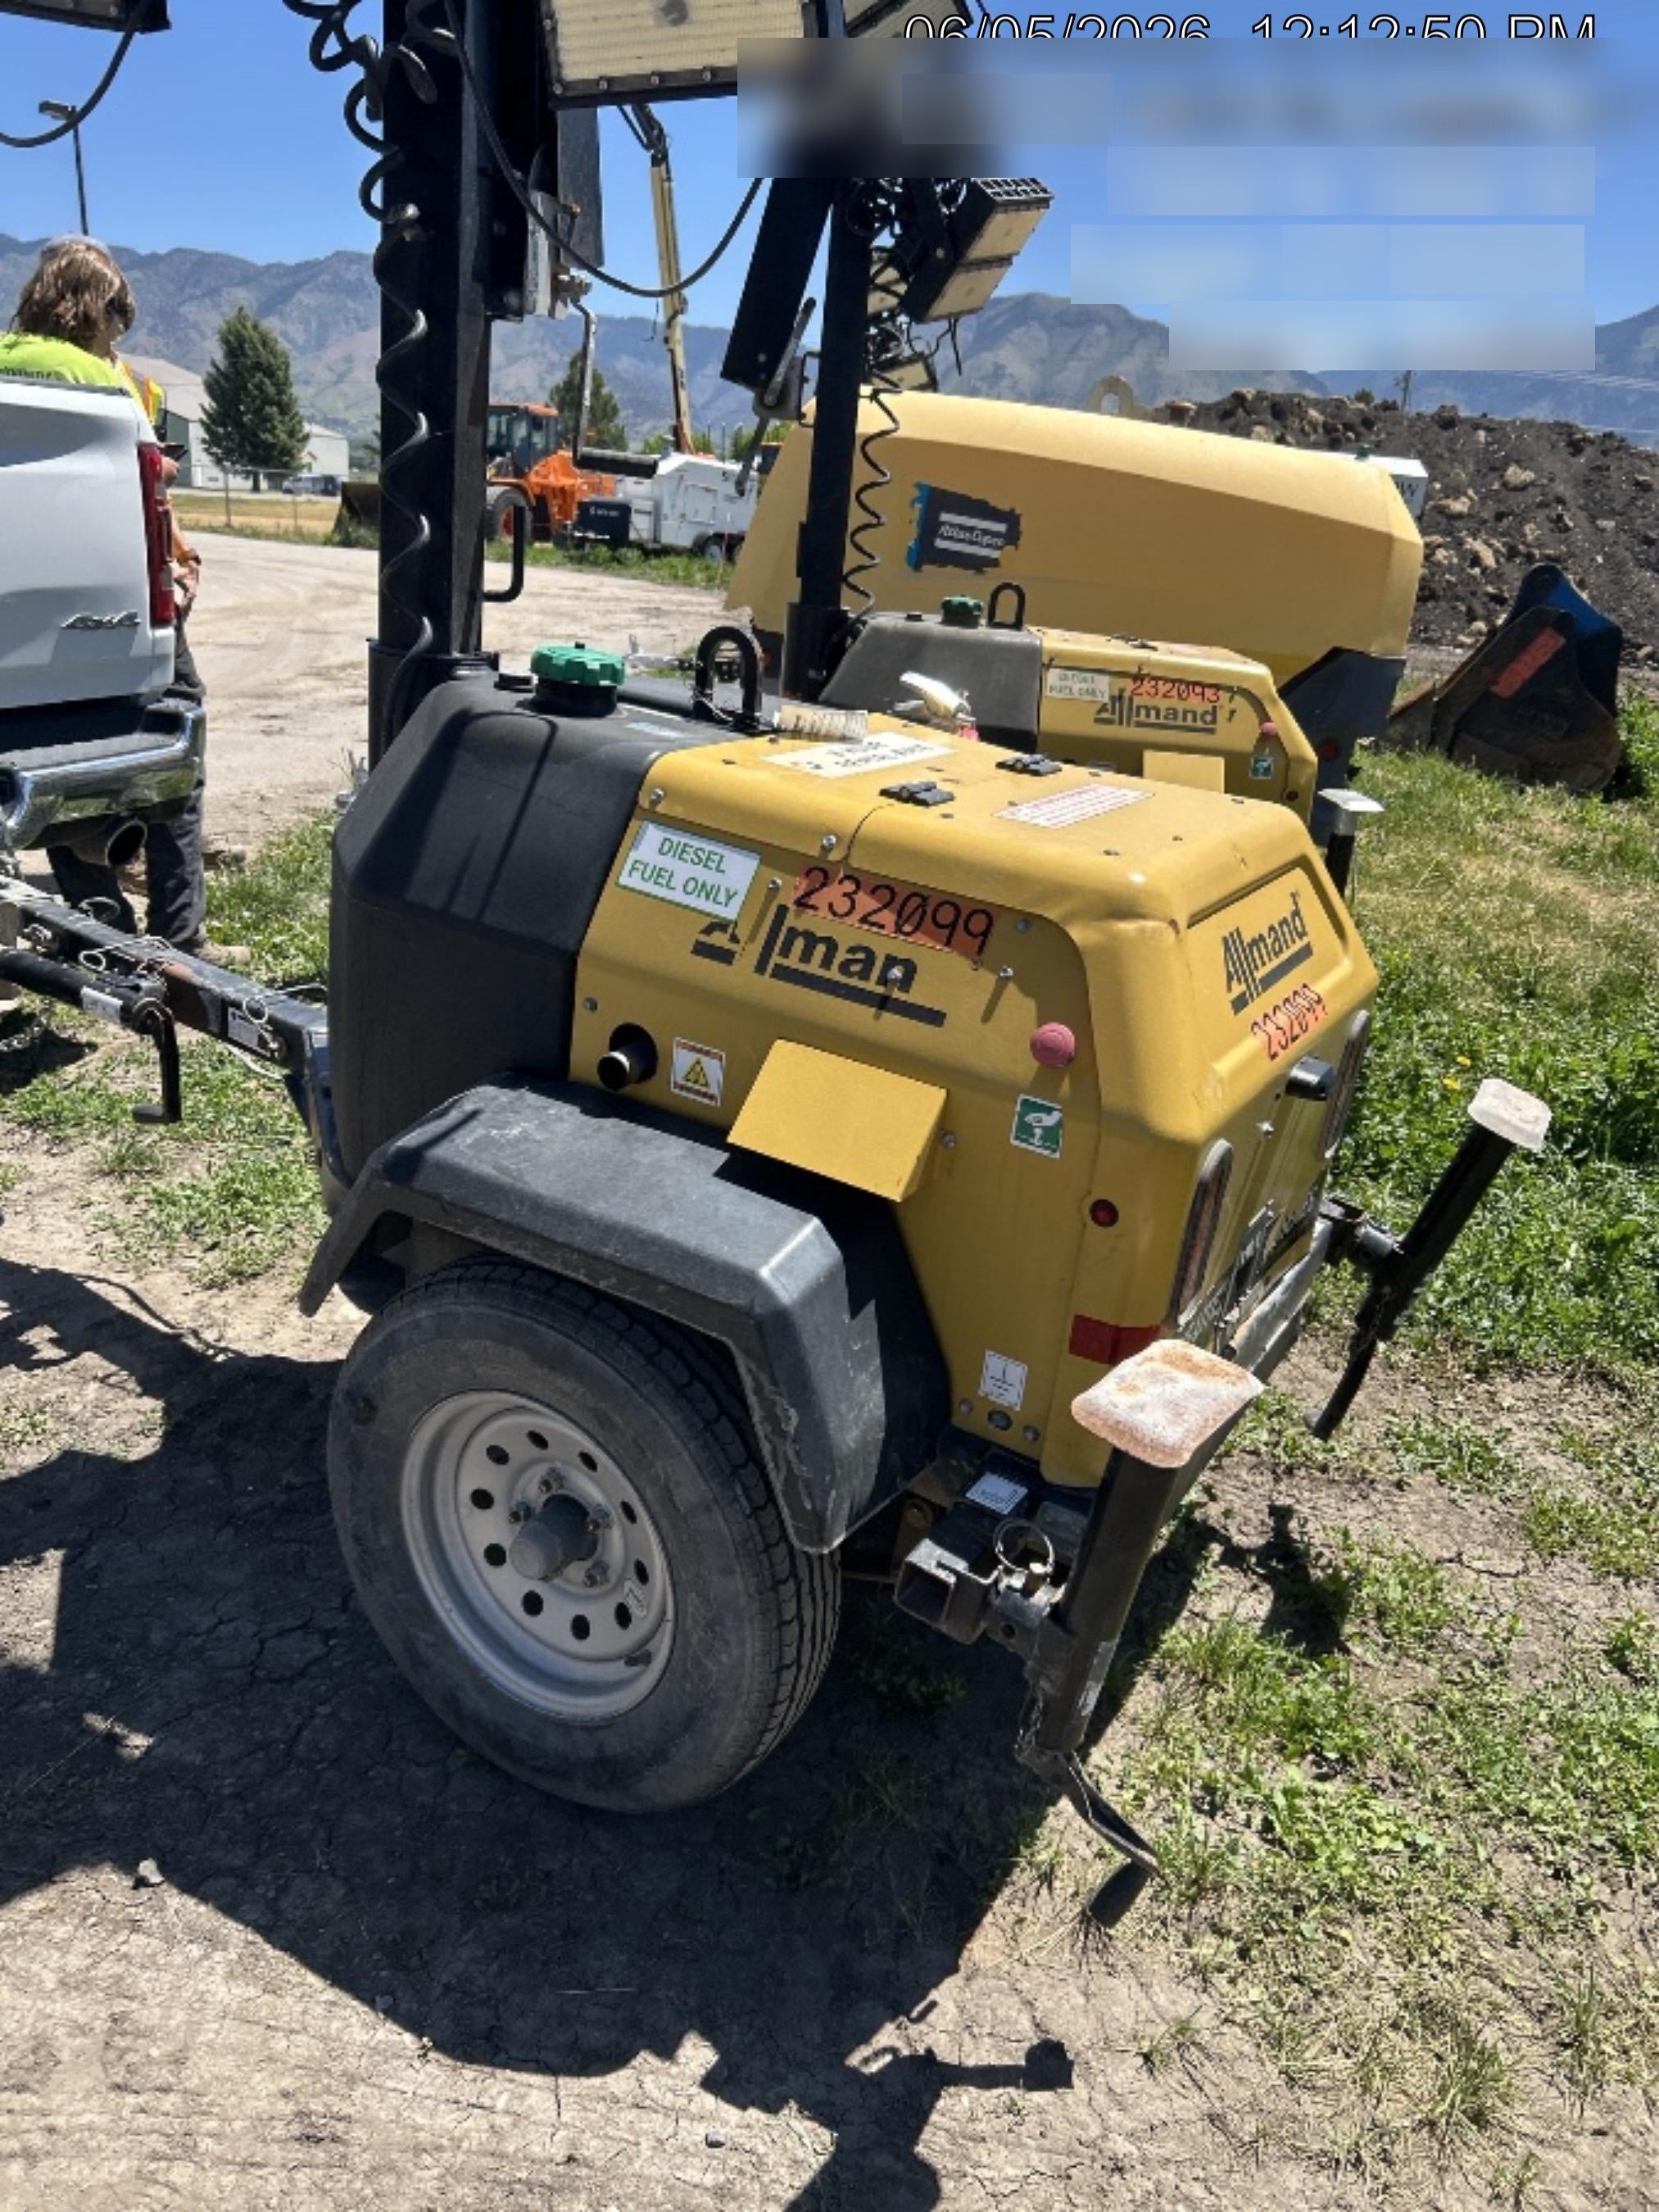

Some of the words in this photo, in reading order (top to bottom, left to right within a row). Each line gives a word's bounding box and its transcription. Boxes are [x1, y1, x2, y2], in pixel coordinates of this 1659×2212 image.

[628, 859, 676, 891] FUEL
[682, 877, 738, 907] ONLY
[658, 837, 726, 875] DIESEL
[792, 866, 994, 956] 232099
[1222, 893, 1310, 1003] Allmand
